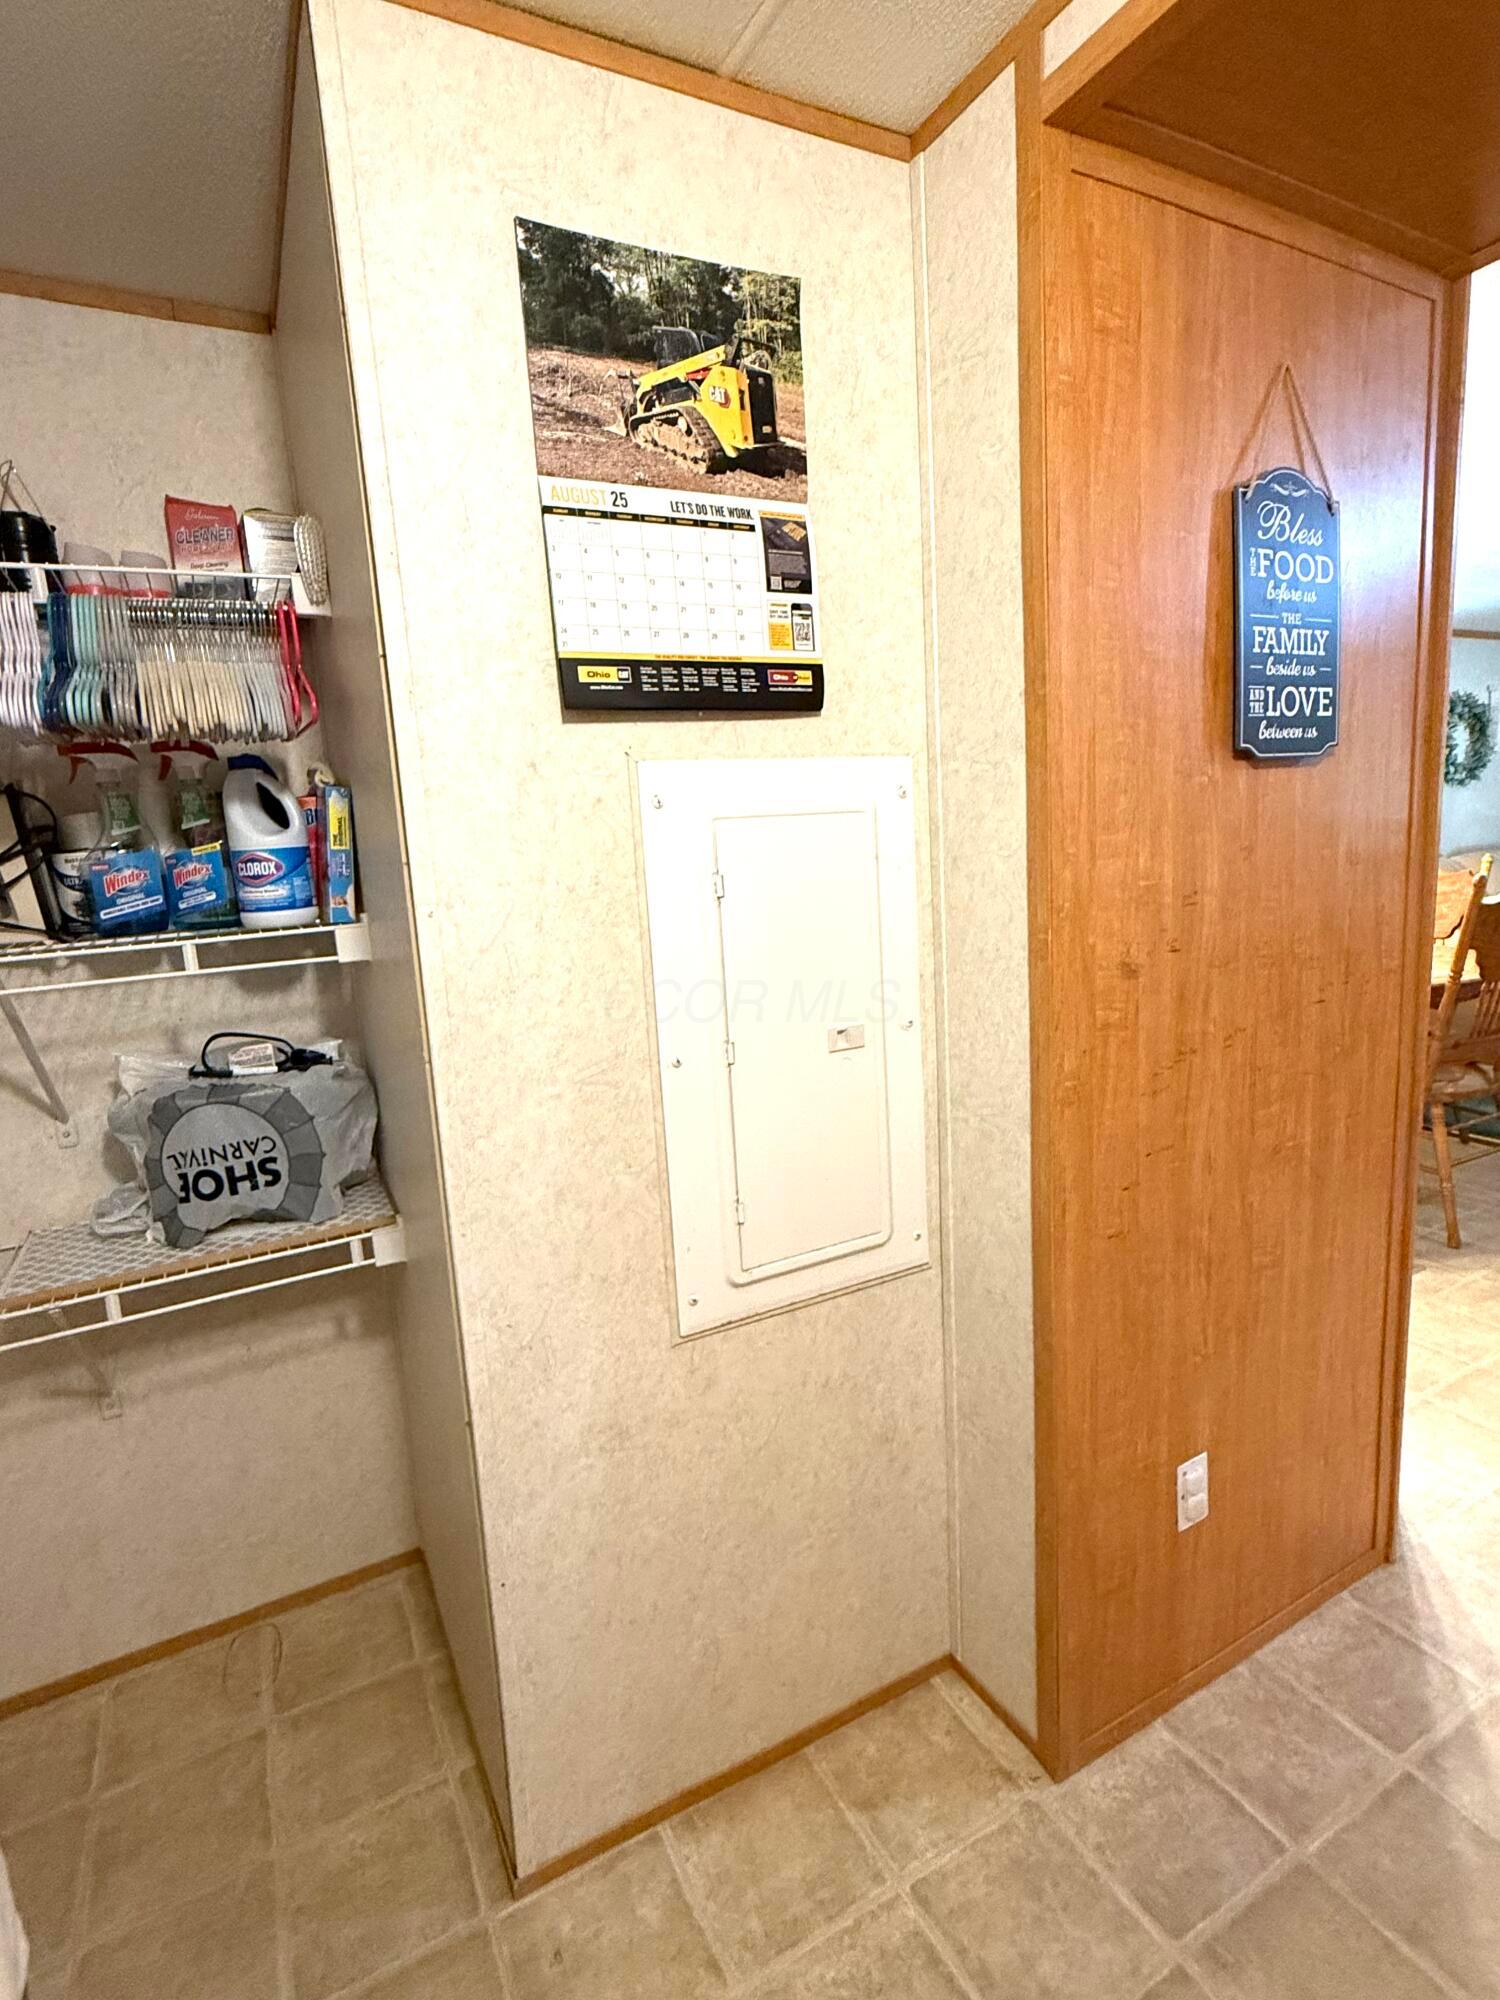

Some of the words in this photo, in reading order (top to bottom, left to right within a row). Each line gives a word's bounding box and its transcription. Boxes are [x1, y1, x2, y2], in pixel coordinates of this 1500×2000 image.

[709, 386, 727, 404] CAT
[551, 485, 607, 505] AUGUST
[611, 491, 629, 508] 25
[670, 501, 694, 514] LET'S
[695, 503, 708, 516] DO
[708, 505, 726, 517] THE
[1257, 500, 1324, 547] Bless
[176, 527, 234, 544] CLEANER
[1257, 548, 1334, 584] FOOD
[1266, 580, 1302, 604] before
[1303, 591, 1318, 603] us
[1281, 611, 1302, 625] THE
[1252, 626, 1330, 656] FAMILY
[586, 670, 611, 678] Ohio
[1266, 655, 1301, 676] beside
[1302, 664, 1317, 677] us
[1249, 689, 1265, 701] AND
[1265, 685, 1334, 717] LOVE
[1249, 701, 1265, 714] THE
[1258, 719, 1303, 739] between
[1303, 727, 1318, 738] us
[173, 863, 213, 890] Windex
[238, 861, 277, 877] CLOROX
[103, 869, 150, 897] Windex
[177, 1156, 282, 1205] SHOE
